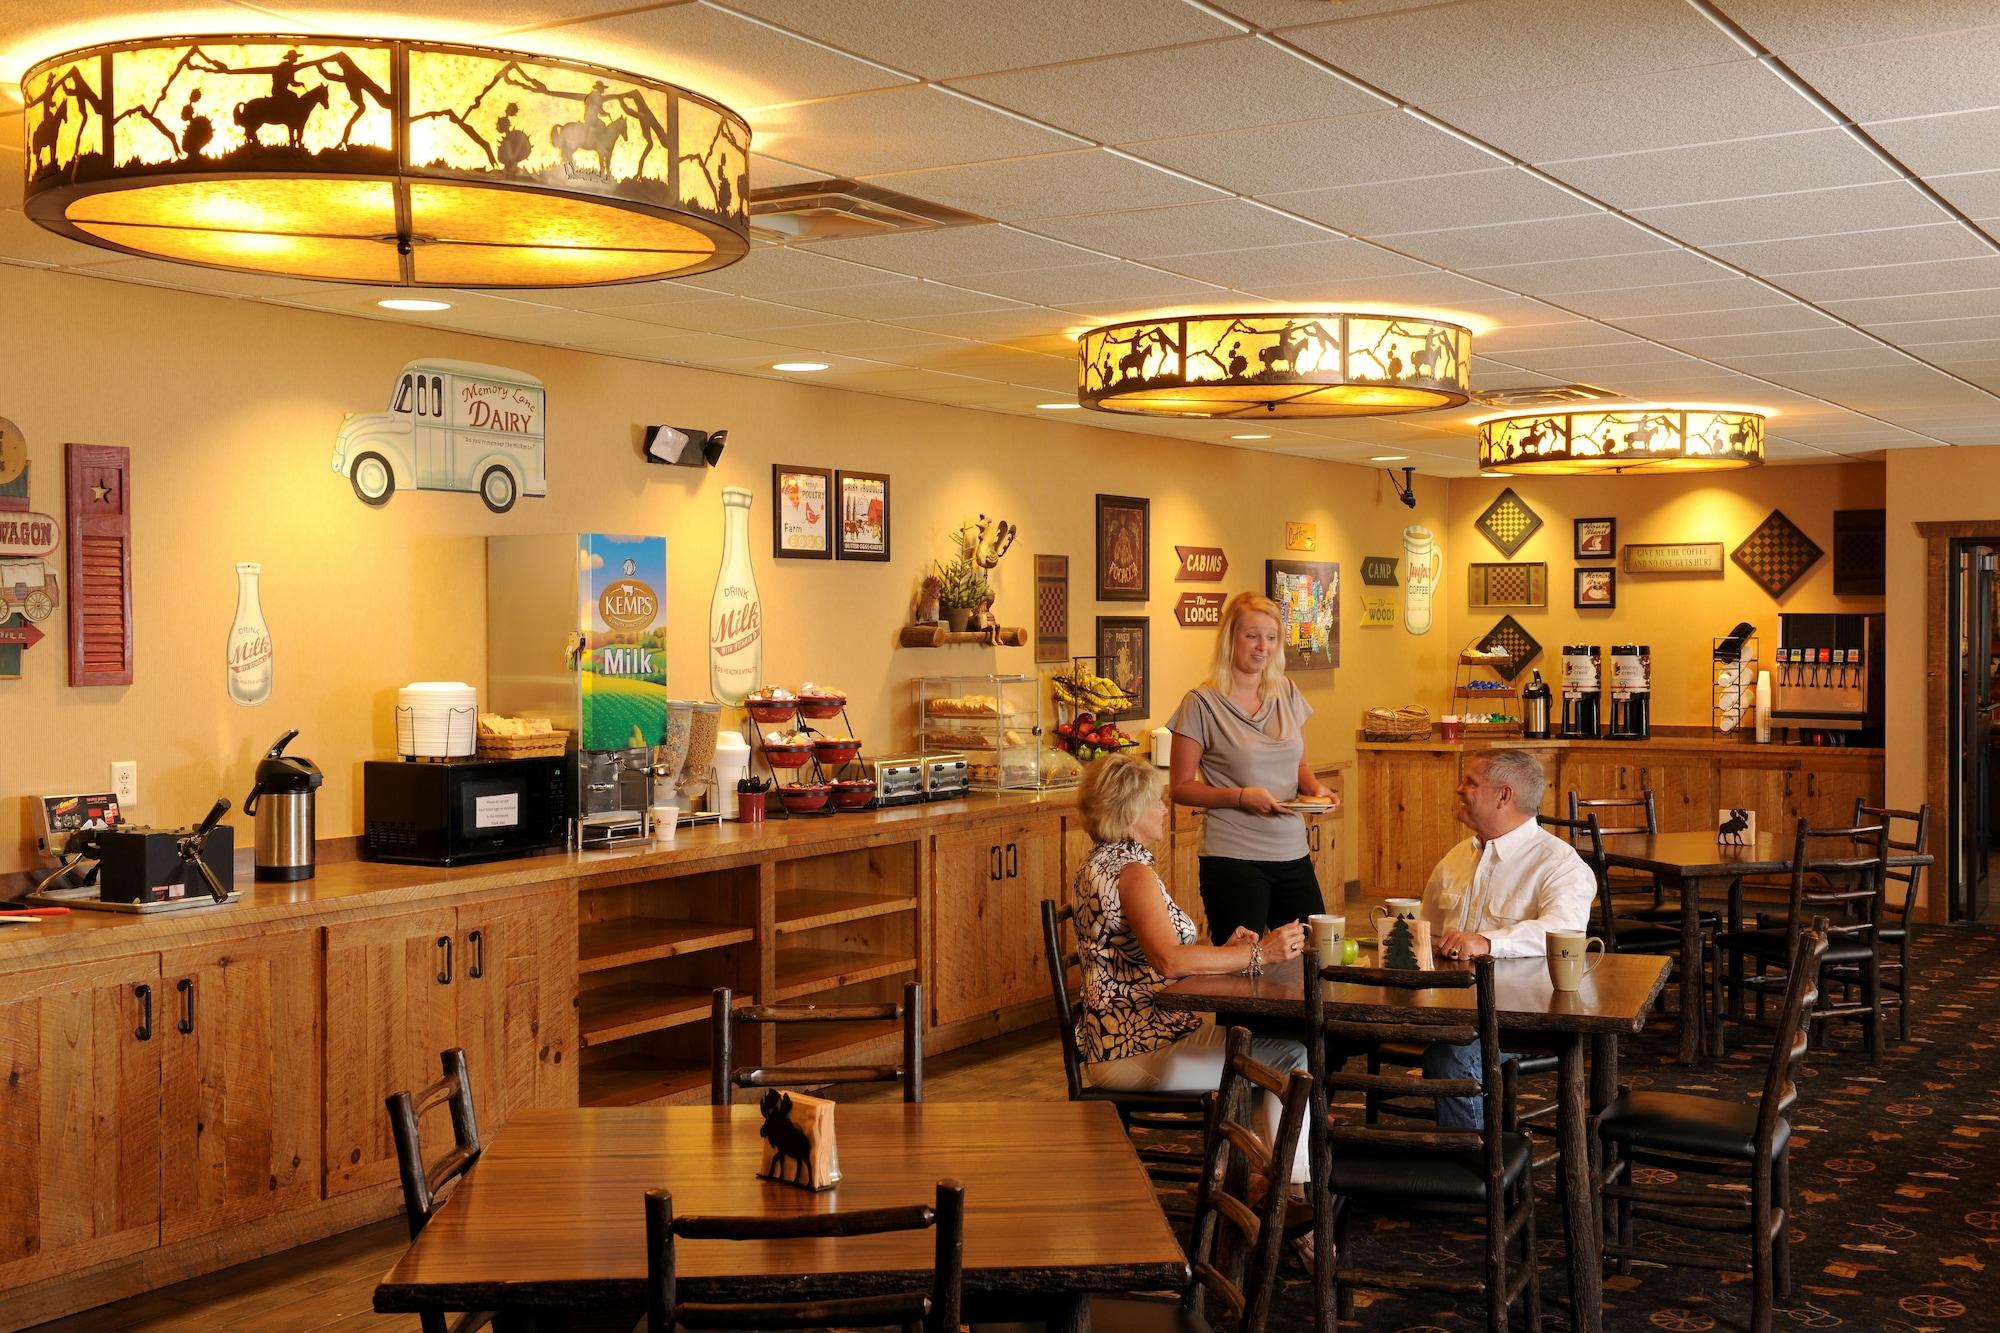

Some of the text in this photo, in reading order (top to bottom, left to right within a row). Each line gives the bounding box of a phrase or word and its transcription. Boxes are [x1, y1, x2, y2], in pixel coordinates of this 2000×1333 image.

[462, 384, 536, 412] Memory Lane
[469, 400, 531, 433] DAIRY
[0, 522, 52, 546] WAGON
[784, 523, 802, 533] Farm
[1186, 554, 1223, 572] CABINS
[1368, 562, 1391, 579] CAMP
[724, 587, 749, 599] DRINK
[1409, 585, 1428, 594] COFFEE
[605, 596, 652, 615] KEMPS
[1196, 595, 1207, 605] The
[712, 601, 760, 643] Milk
[1184, 607, 1218, 623] LODGE
[1369, 608, 1394, 621] WOODS
[229, 636, 270, 665] Milk
[604, 648, 653, 675] Milk
